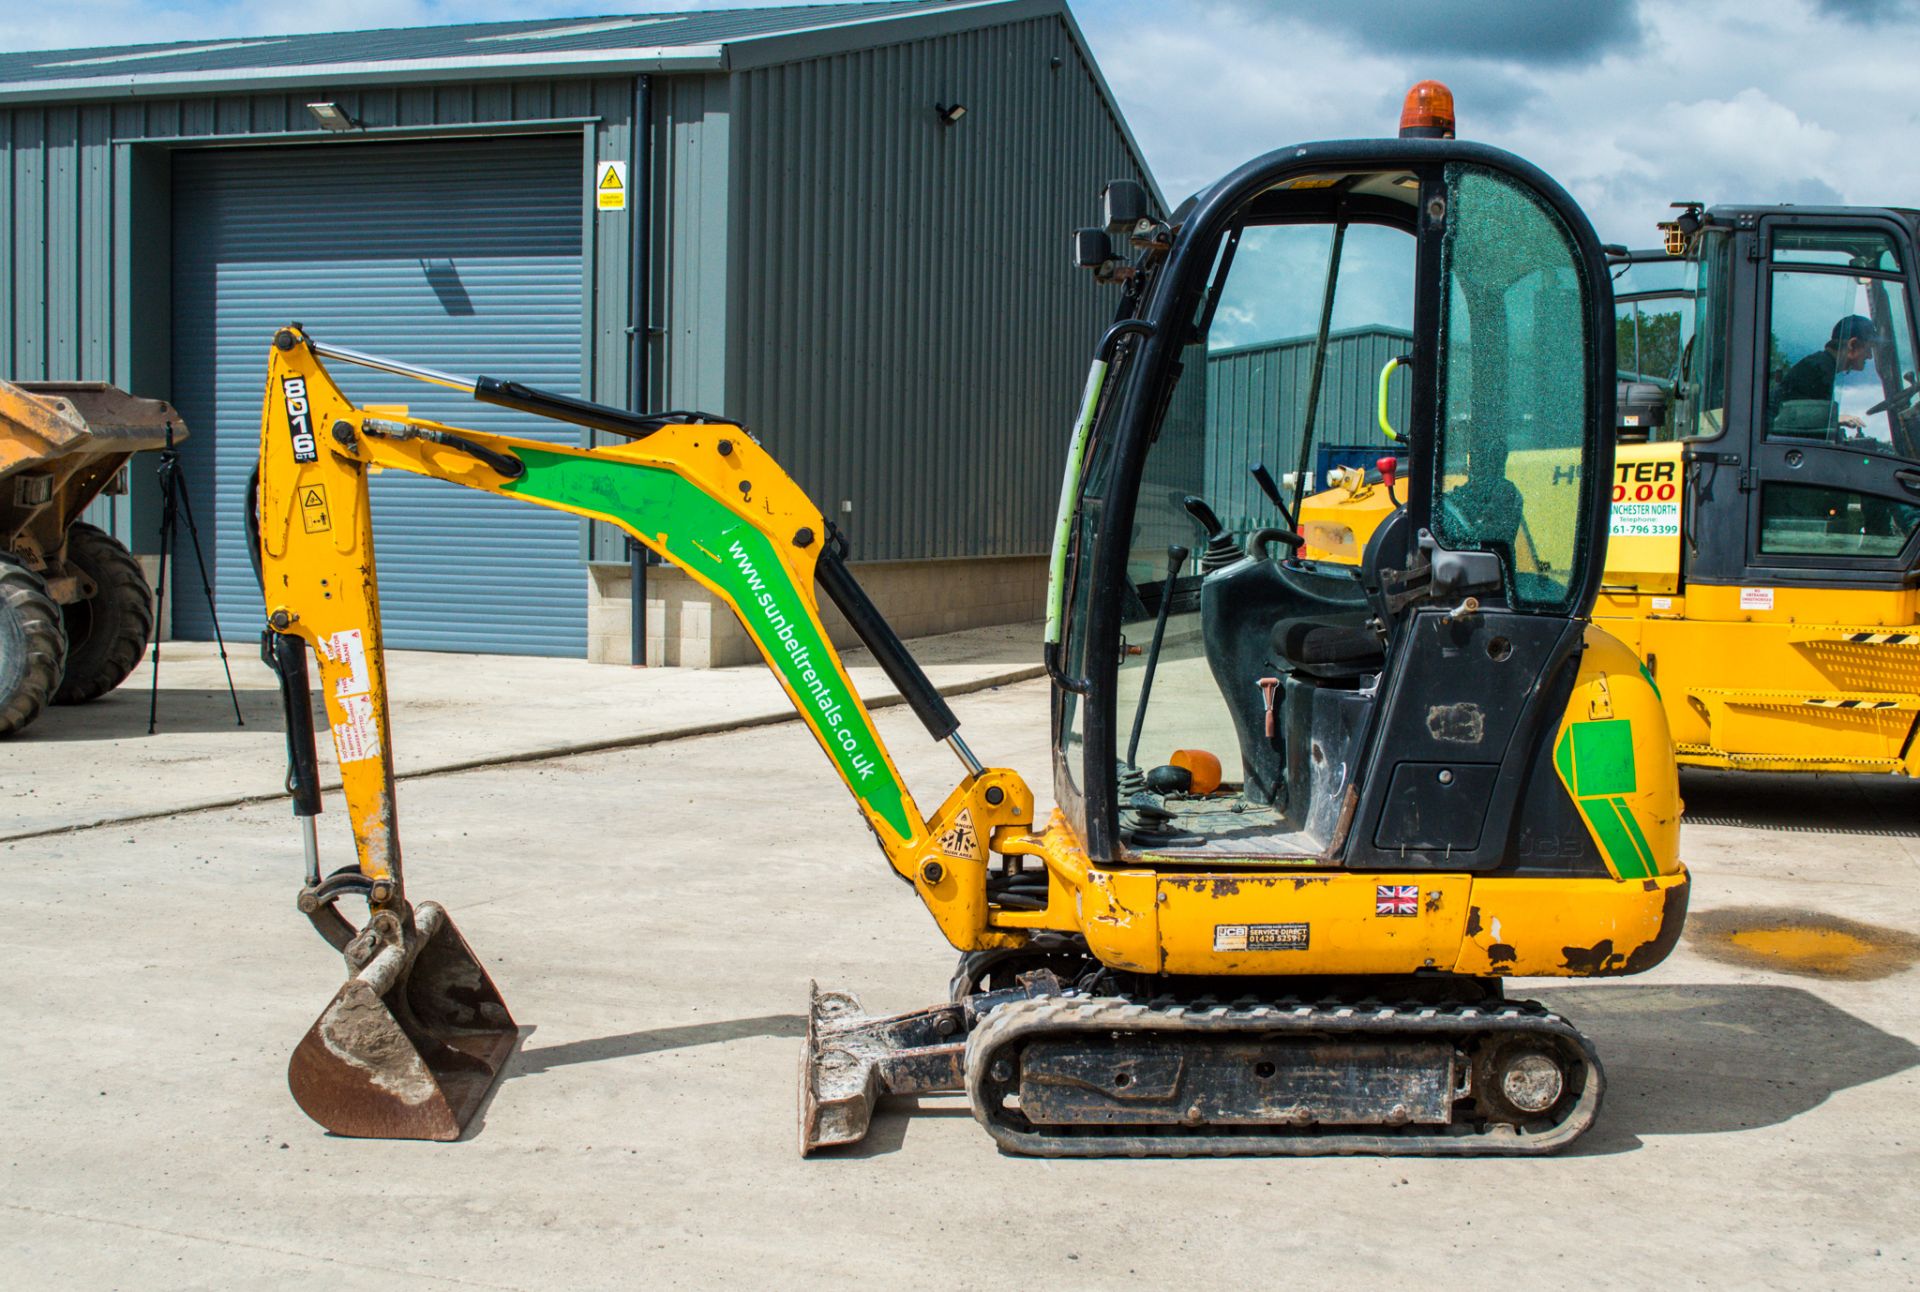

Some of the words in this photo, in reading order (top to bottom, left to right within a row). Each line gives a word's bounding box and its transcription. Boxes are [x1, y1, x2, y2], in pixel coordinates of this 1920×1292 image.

[283, 379, 316, 453] 8016
[1612, 484, 1676, 502] 0.00
[1612, 504, 1650, 515] NCHESTER
[1651, 504, 1677, 515] NORTH
[1612, 525, 1650, 534] 61-796
[1652, 525, 1678, 534] 3399
[728, 540, 874, 782] www.sunbeltrentals.co.uk
[1219, 927, 1246, 937] JCB
